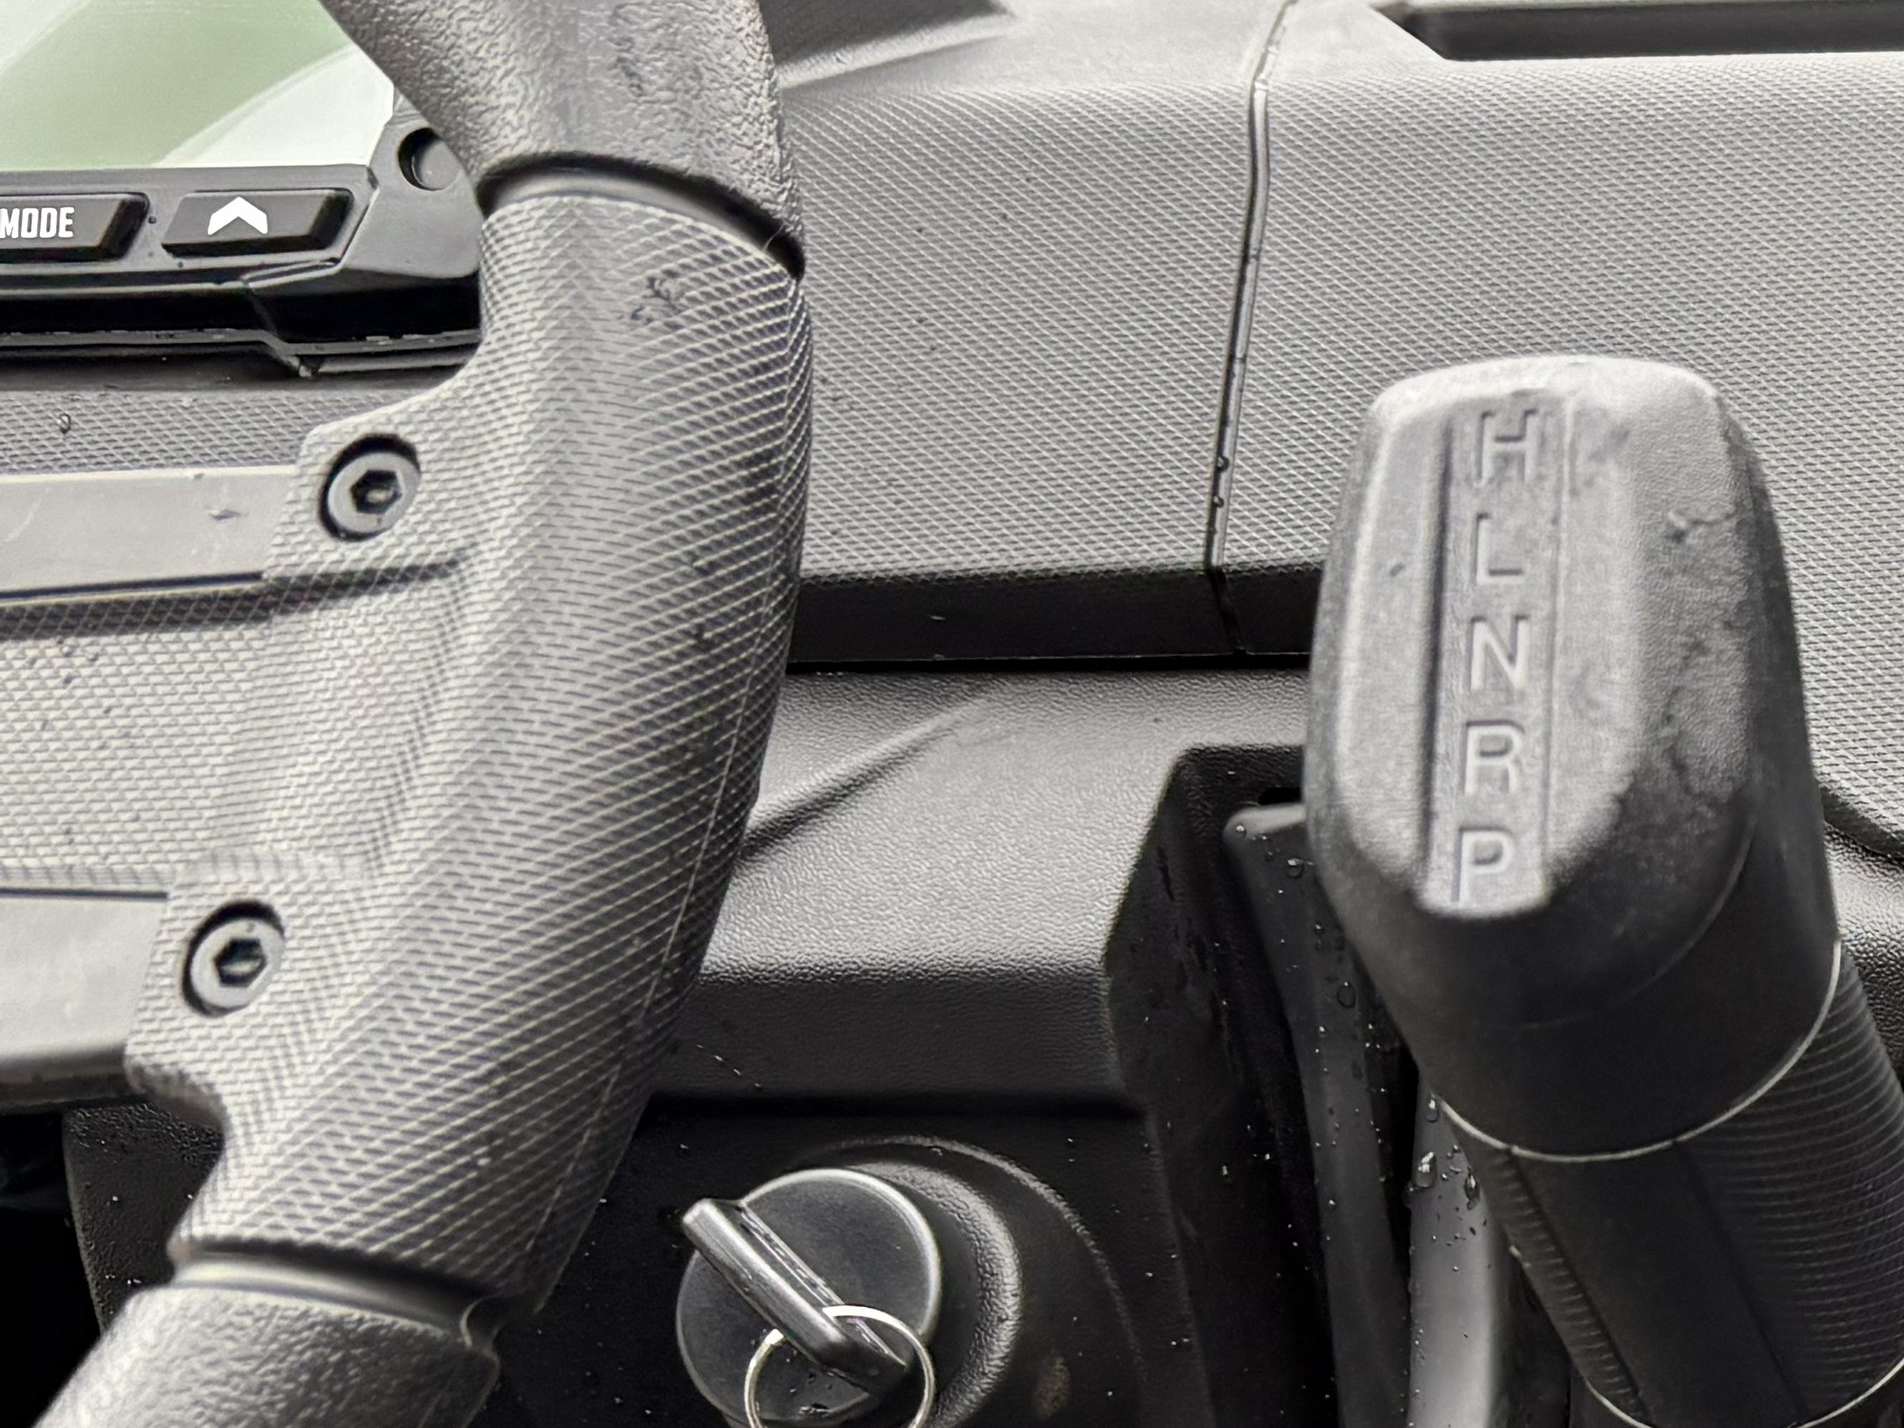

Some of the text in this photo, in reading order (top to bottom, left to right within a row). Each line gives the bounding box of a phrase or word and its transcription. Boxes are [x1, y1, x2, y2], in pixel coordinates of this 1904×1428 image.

[0, 206, 75, 240] MODE
[1476, 408, 1539, 488] H
[1474, 512, 1525, 586] L
[1469, 614, 1532, 691] N
[1462, 720, 1526, 799] R
[1451, 827, 1520, 906] P
